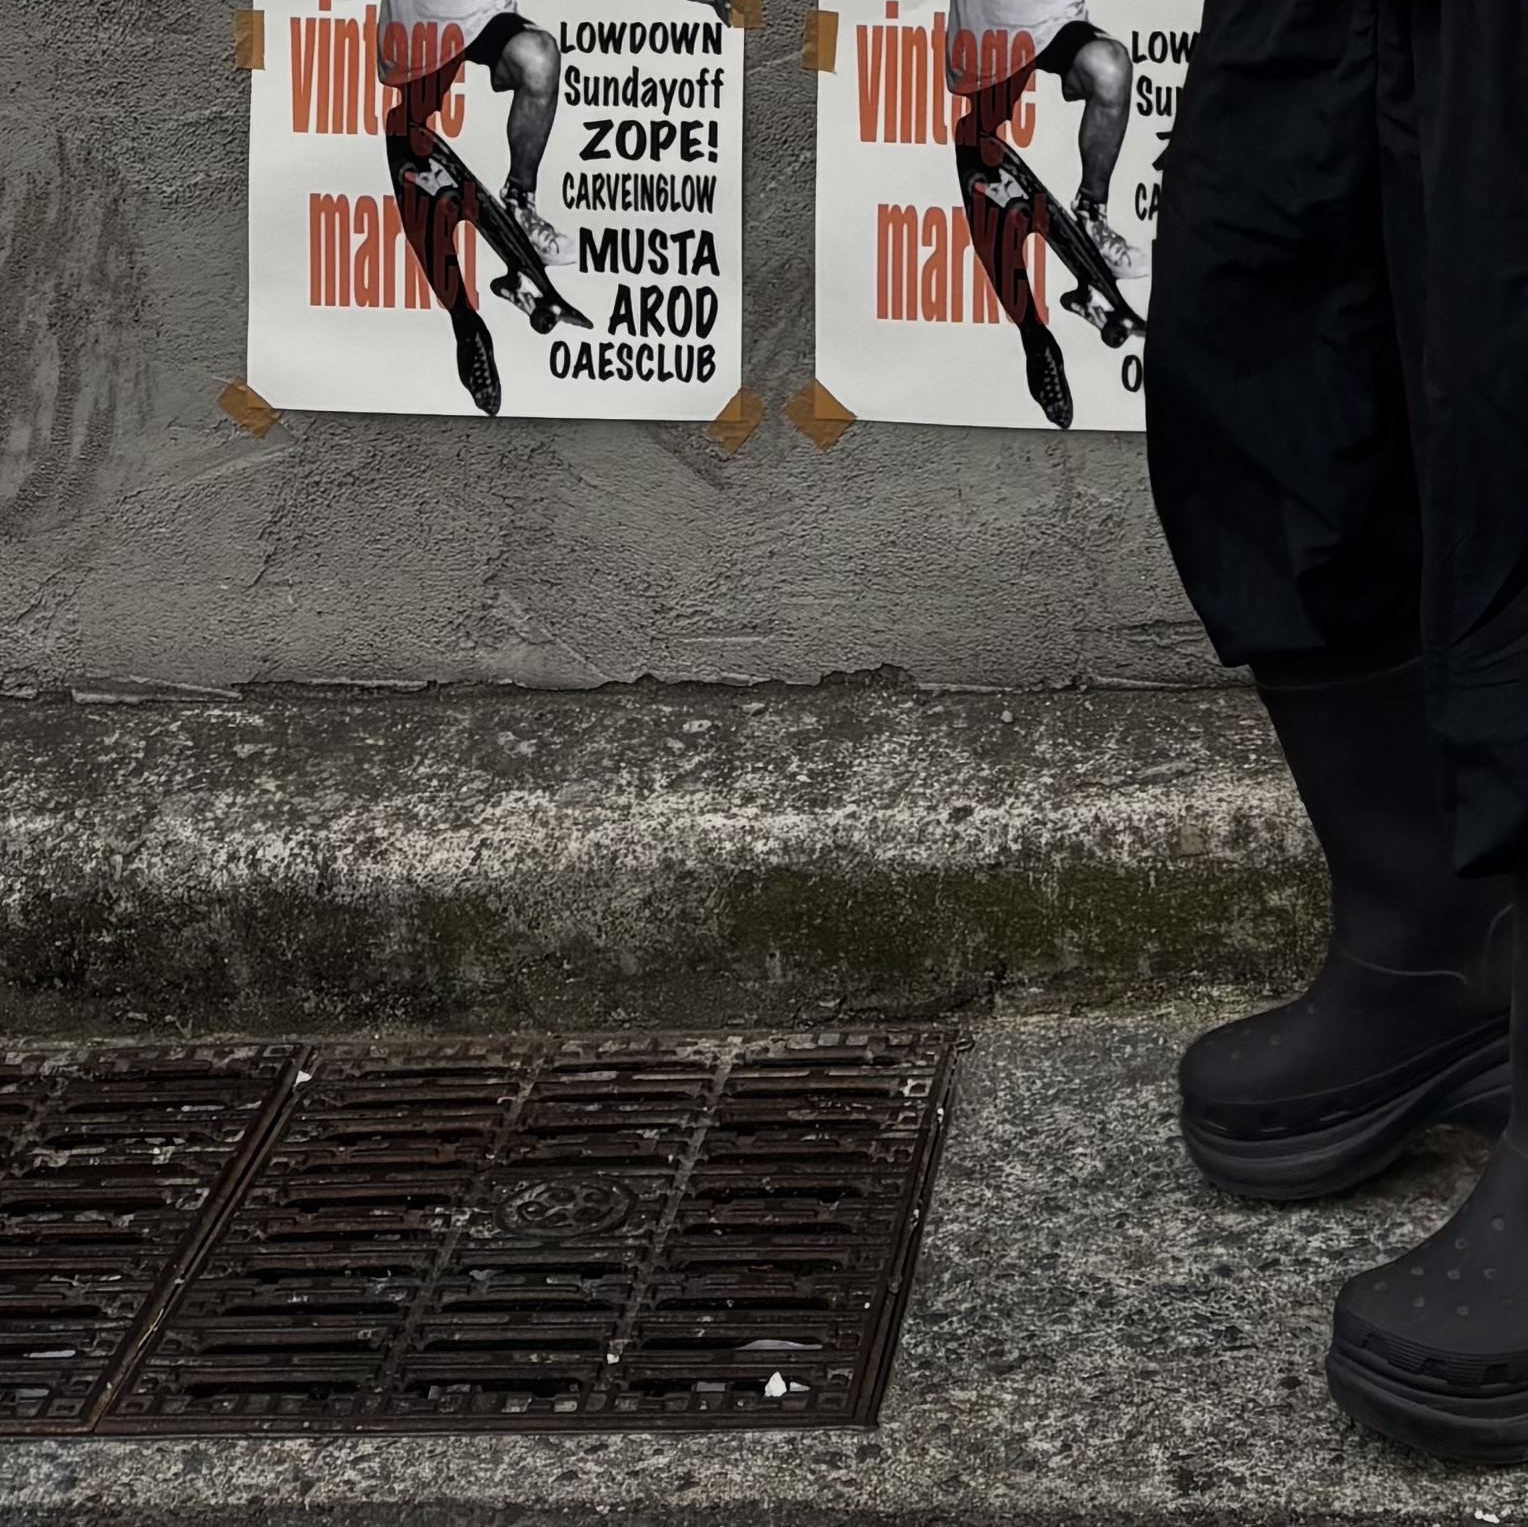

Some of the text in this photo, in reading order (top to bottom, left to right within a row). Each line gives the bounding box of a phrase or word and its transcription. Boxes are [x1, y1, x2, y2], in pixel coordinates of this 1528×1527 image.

[560, 21, 722, 55] LOWDOWN
[564, 66, 724, 115] Sundayoff
[856, 1, 1037, 167] vintage
[579, 119, 719, 163] ZOPE!
[309, 169, 480, 311] market
[579, 227, 720, 277] MUSTA
[877, 181, 1050, 326] market
[608, 284, 719, 339] AROD
[549, 341, 717, 383] OAESCLUB
